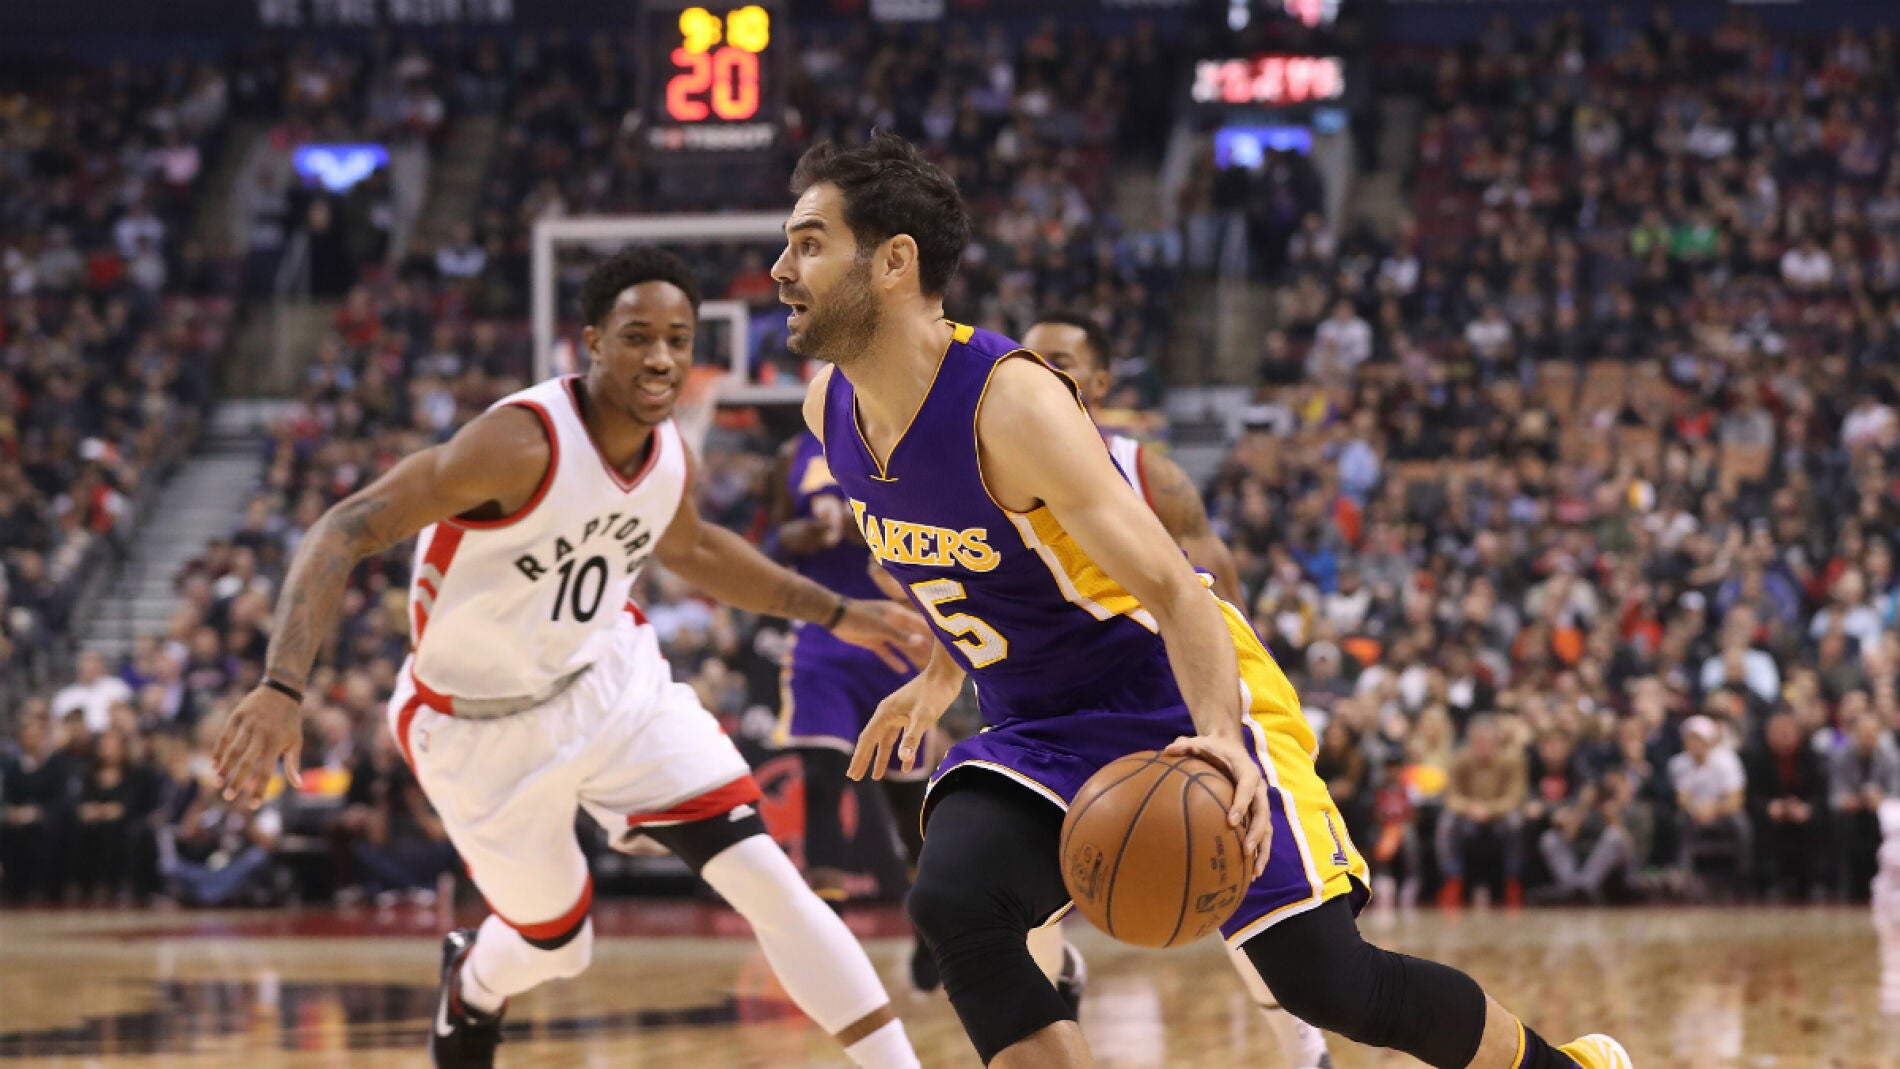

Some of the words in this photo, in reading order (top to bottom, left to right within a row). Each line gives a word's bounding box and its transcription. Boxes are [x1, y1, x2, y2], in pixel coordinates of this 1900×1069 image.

[666, 46, 760, 121] 20
[551, 555, 609, 623] 10
[909, 577, 1009, 669] 5
